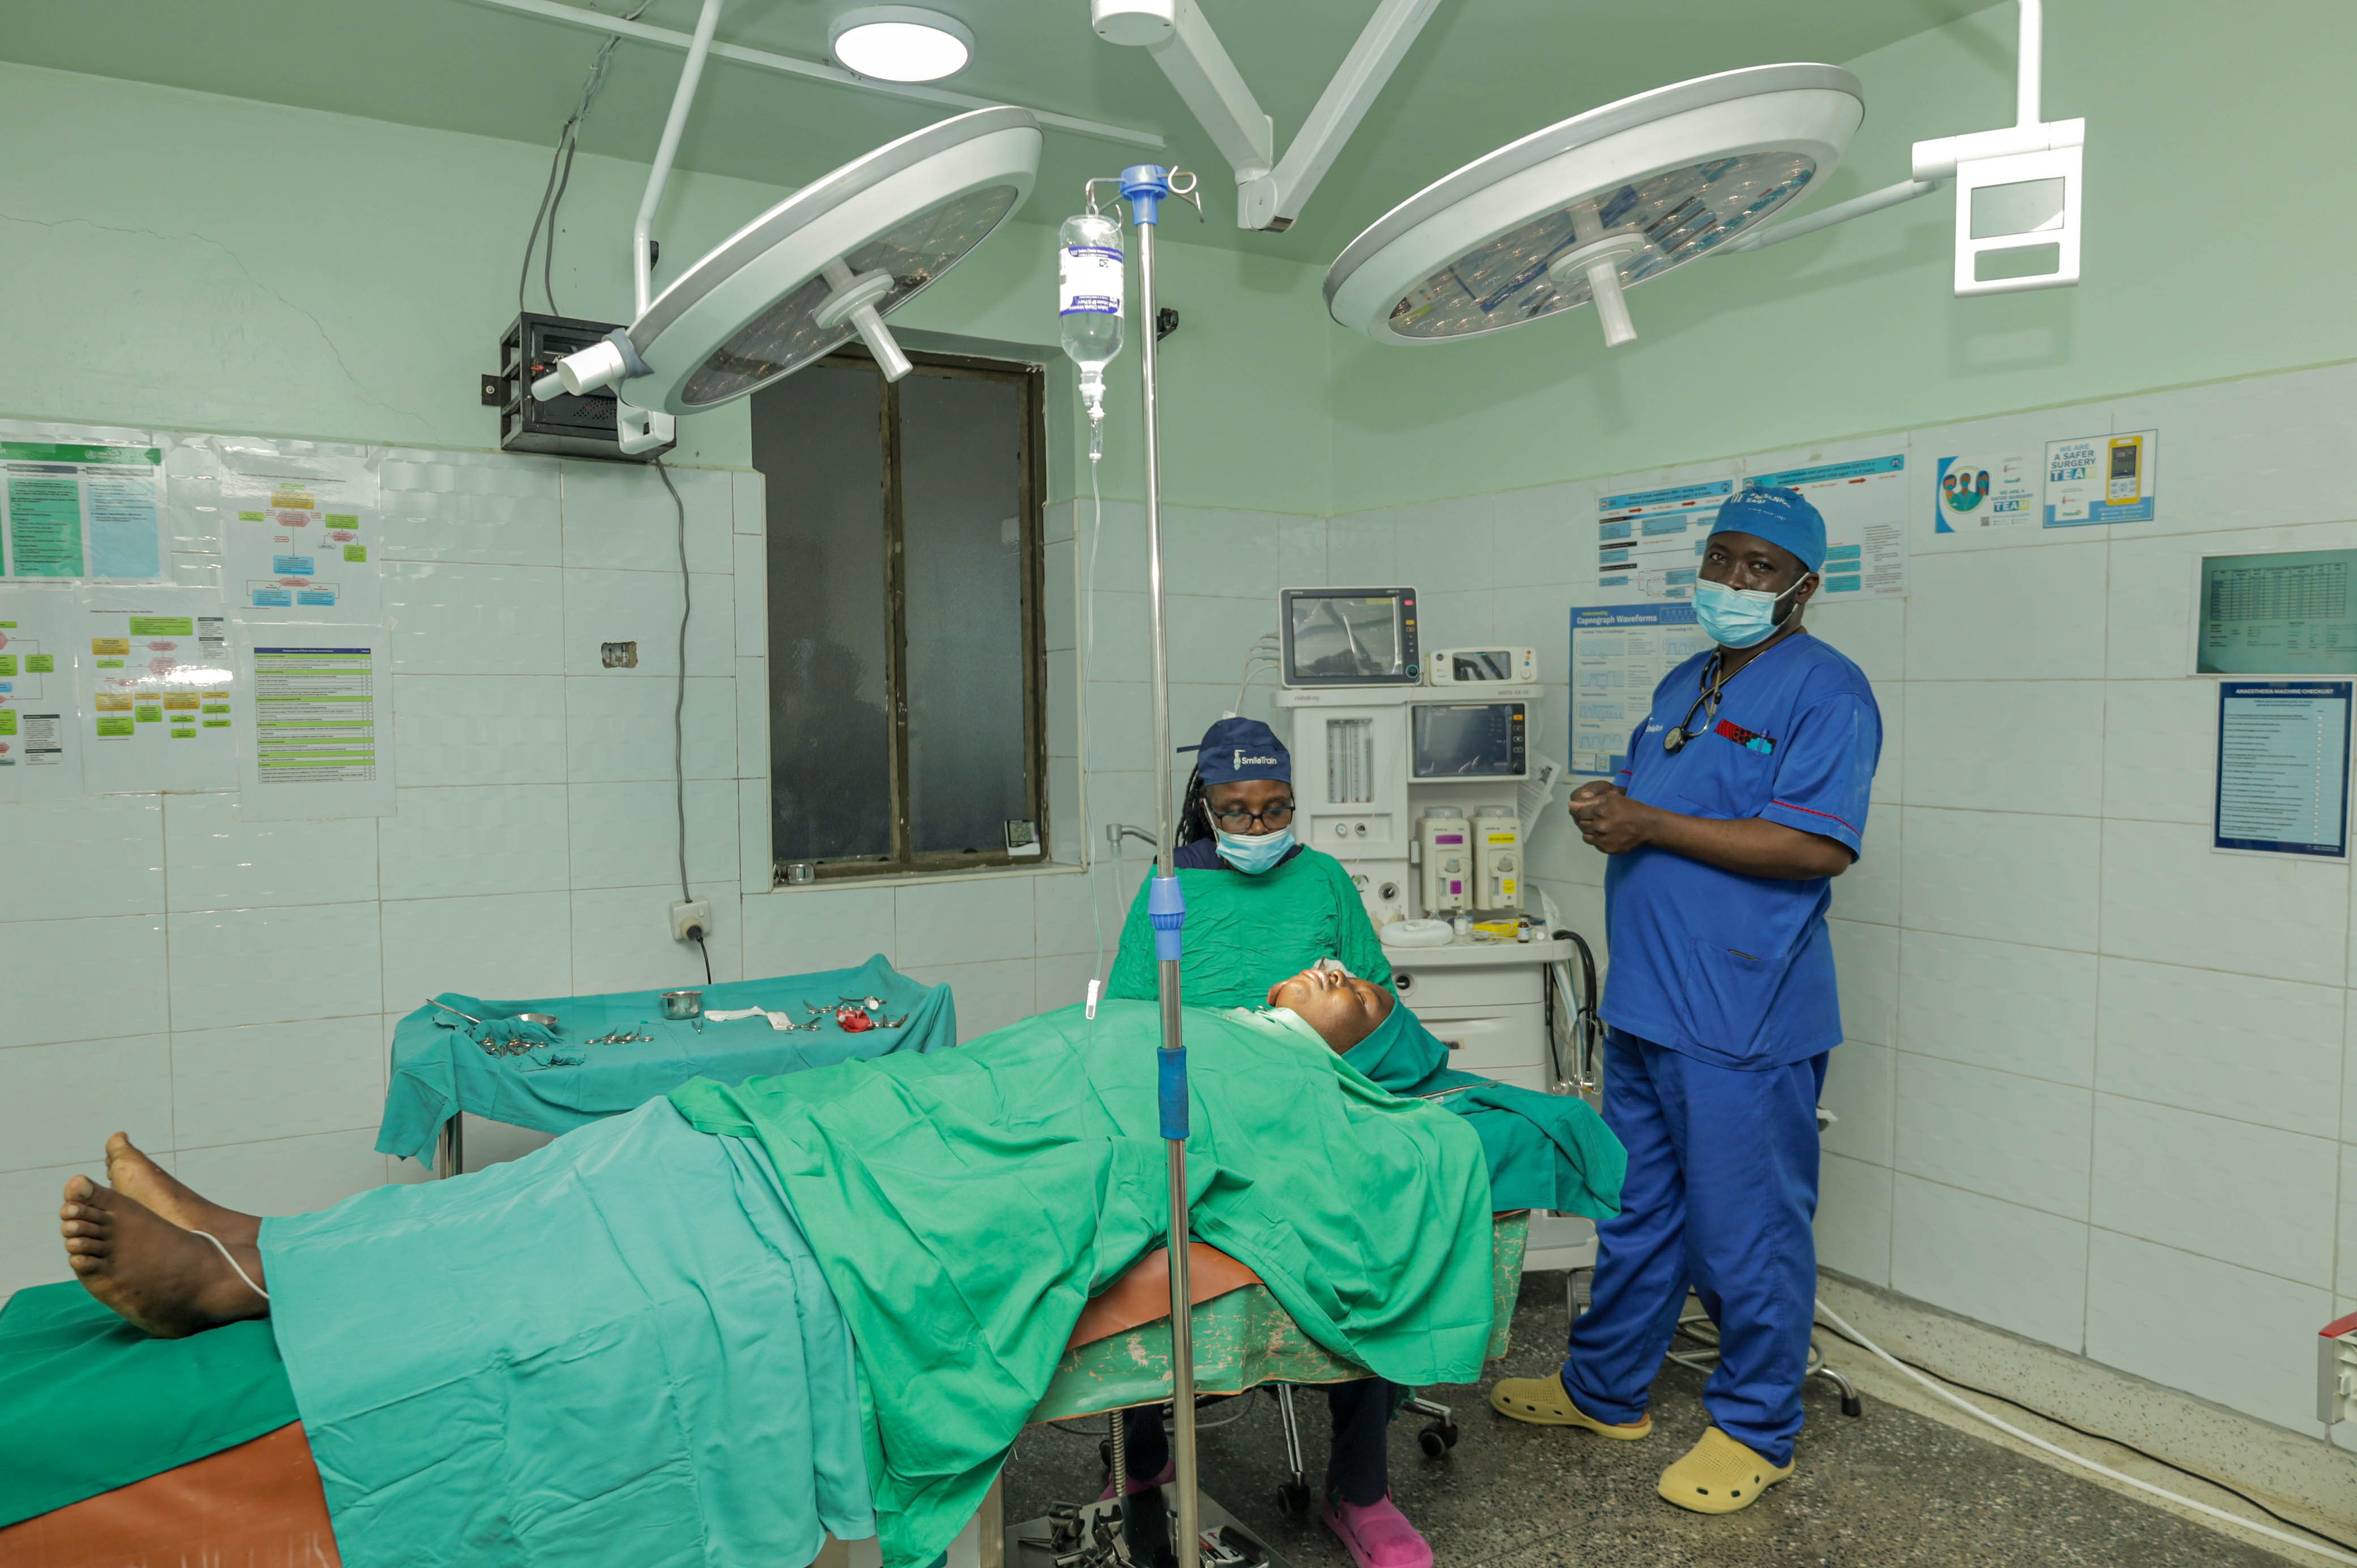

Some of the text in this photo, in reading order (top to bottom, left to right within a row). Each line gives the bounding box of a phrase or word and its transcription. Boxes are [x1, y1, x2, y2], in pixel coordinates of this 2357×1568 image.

[2063, 450, 2095, 460] SAFER
[2052, 458, 2096, 469] SURGERY
[2050, 466, 2096, 482] TEAM
[1994, 500, 2030, 512] TEAM
[1577, 614, 1657, 625] Capnograph Waveforms
[1241, 756, 1278, 765] SmileTrain
